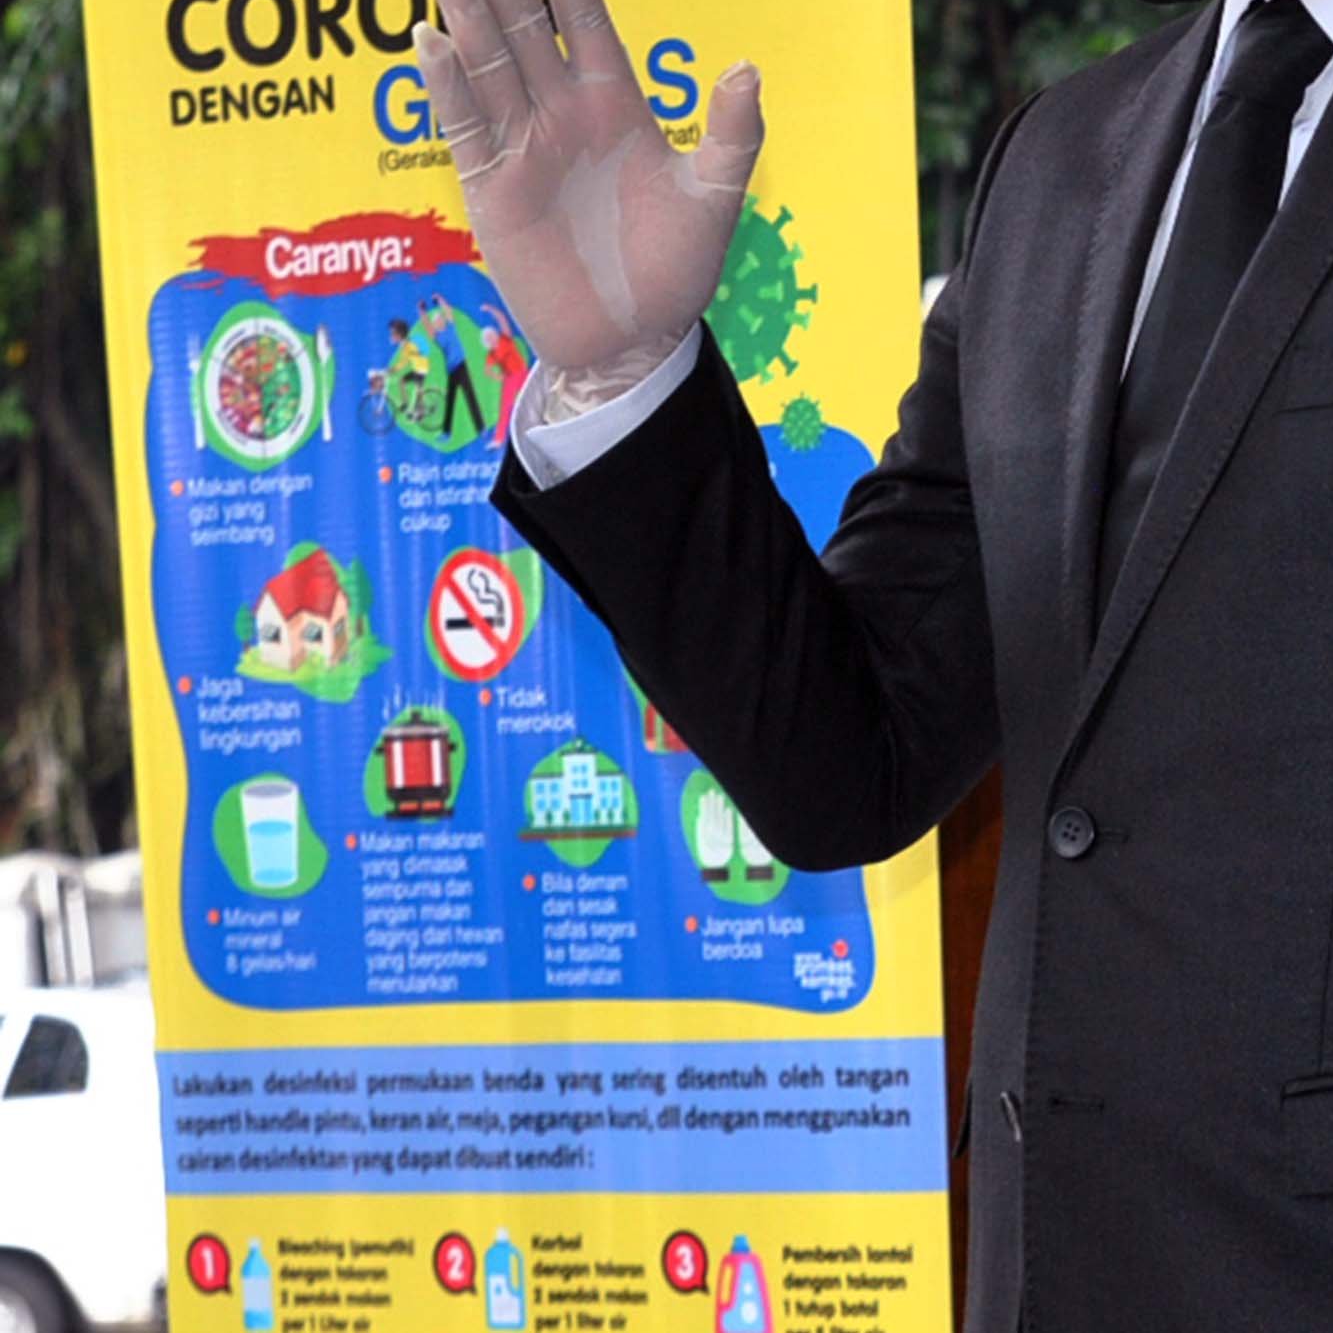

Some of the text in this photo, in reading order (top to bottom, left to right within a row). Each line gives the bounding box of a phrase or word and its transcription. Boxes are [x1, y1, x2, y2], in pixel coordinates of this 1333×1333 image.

[170, 75, 335, 127] DENGAN
[377, 149, 453, 177] (Geraka
[265, 234, 413, 283] Caranya:
[188, 473, 313, 498] Makan dengan
[399, 461, 501, 487] Rajin olahrag
[399, 487, 432, 509] dan
[189, 502, 266, 527] gizi yang
[401, 513, 451, 534] cukup
[191, 525, 275, 547] seimbang
[197, 676, 243, 703] Jaga
[496, 685, 547, 708] Tidak
[199, 699, 301, 723] kebersihan
[497, 711, 576, 734] merokok
[200, 727, 302, 755] lingkungan
[360, 832, 414, 852] Makan
[361, 859, 400, 880] yang
[444, 879, 473, 897] dan
[542, 871, 573, 893] Bila
[223, 905, 302, 927] Minum air
[420, 902, 472, 921] makan
[542, 896, 574, 916] dan
[224, 928, 283, 950] mineral
[701, 912, 805, 943] Jangan lupa
[544, 943, 565, 963] ke
[702, 942, 763, 961] berdoa
[366, 953, 405, 974] yang
[172, 1063, 909, 1098] Lakukan desinfeksi permukaan benda yang sering disentuh oleh tangan
[176, 1103, 911, 1137] seperti handle pintu, keran air, meja, pegangan kursi, dll dengan menggunakan
[178, 1148, 235, 1172] cairan
[239, 1145, 347, 1171] desinfektan
[352, 1152, 394, 1175] yang
[397, 1146, 450, 1174] dapat
[456, 1144, 511, 1169] dibuat
[201, 1247, 214, 1281] 1
[447, 1246, 465, 1281] 2
[534, 1258, 590, 1283] dengan
[676, 1244, 695, 1281] 3
[280, 1263, 331, 1286] dengan
[784, 1271, 842, 1294] dengan
